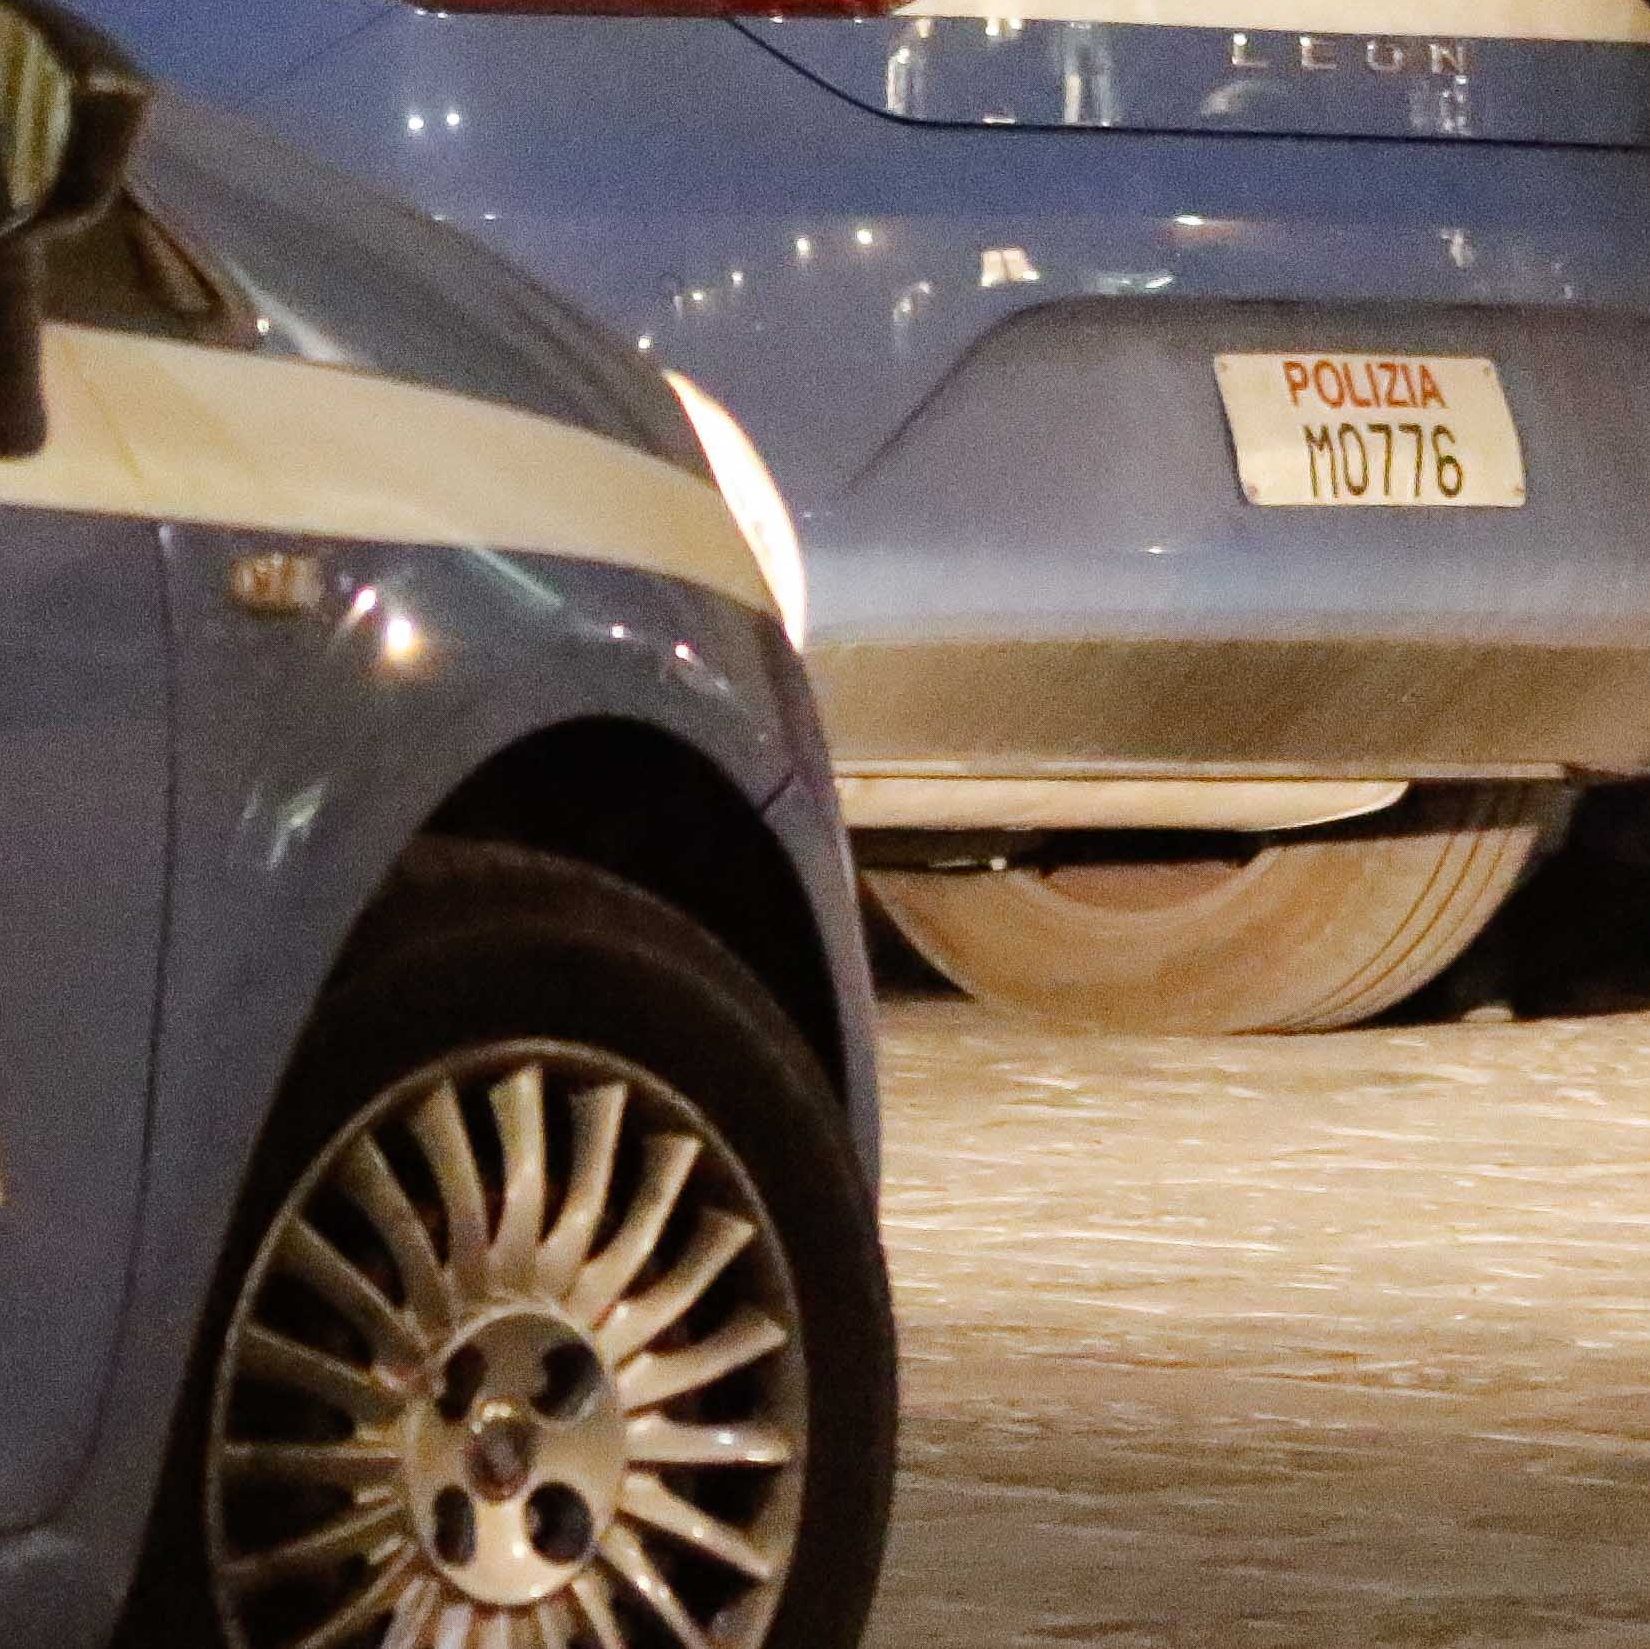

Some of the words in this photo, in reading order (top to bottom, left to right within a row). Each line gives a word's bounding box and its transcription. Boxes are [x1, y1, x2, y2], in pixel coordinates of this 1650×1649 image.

[1231, 32, 1470, 74] LEON
[1282, 359, 1448, 409] POLIZIA
[1302, 422, 1464, 498] M0776
